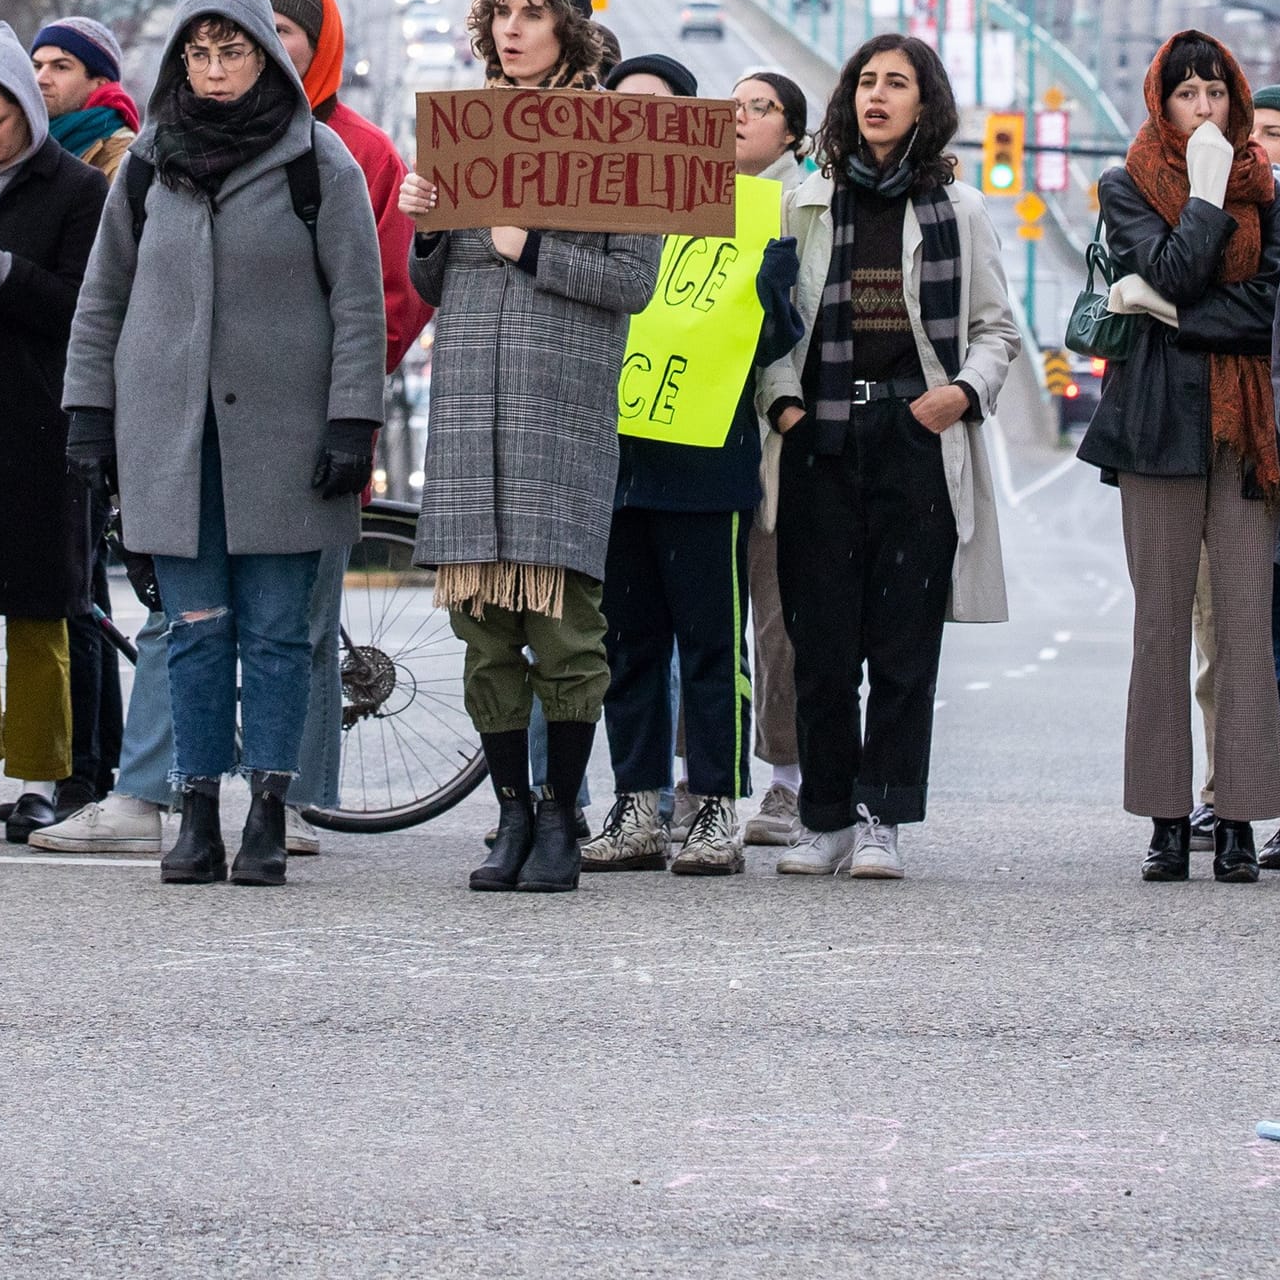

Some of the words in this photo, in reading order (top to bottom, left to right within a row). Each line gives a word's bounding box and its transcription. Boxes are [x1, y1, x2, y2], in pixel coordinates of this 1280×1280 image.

[429, 95, 494, 149] NO
[503, 92, 734, 148] CONSENT
[432, 157, 498, 209] NO
[502, 151, 736, 213] PIPELINE
